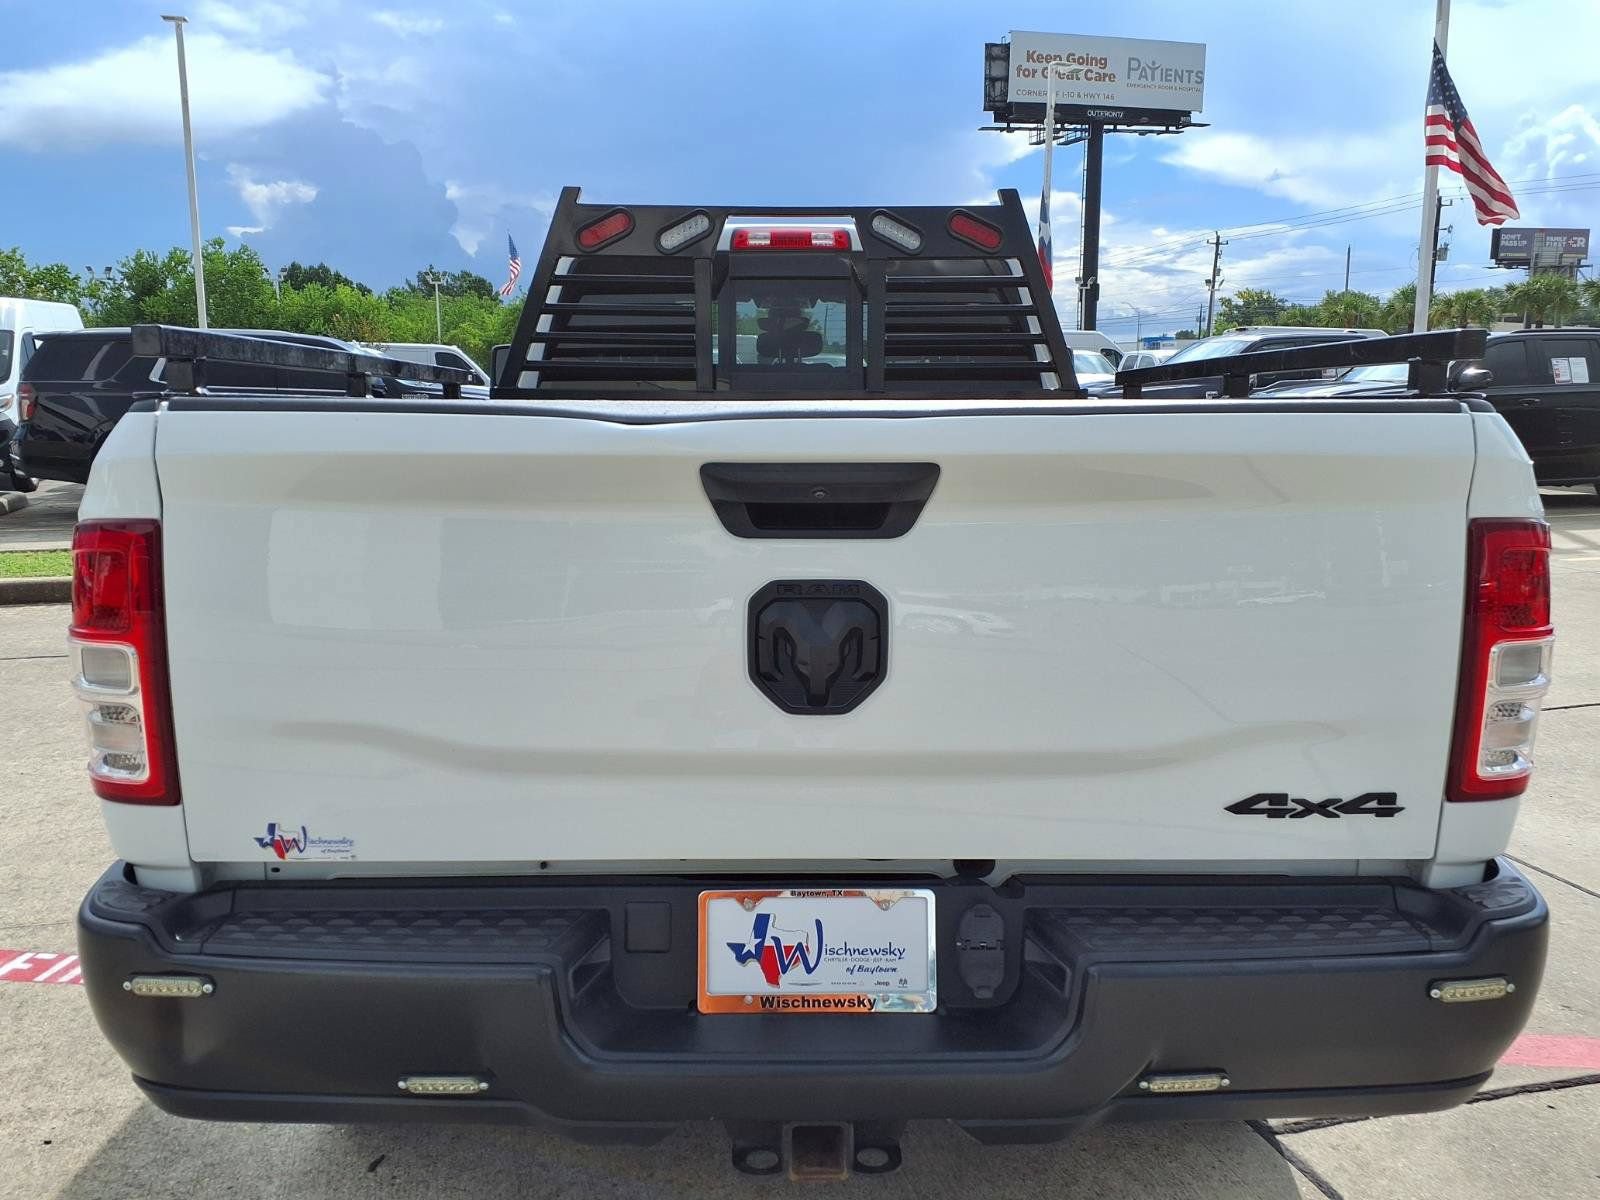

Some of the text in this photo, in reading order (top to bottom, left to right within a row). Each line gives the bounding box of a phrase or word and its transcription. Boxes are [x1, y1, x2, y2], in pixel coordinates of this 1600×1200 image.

[1066, 52, 1107, 69] Going
[1016, 64, 1038, 78] for
[1084, 68, 1116, 82] Care
[1127, 57, 1204, 85] PATIENTS
[1016, 89, 1048, 97] CORNER
[1083, 92, 1101, 100] HWY
[1223, 792, 1406, 819] 4x4
[790, 889, 843, 898] Baytown, TX
[845, 964, 898, 975] of Baytown
[874, 979, 891, 987] Jeep
[760, 995, 877, 1011] Wischnewsky
